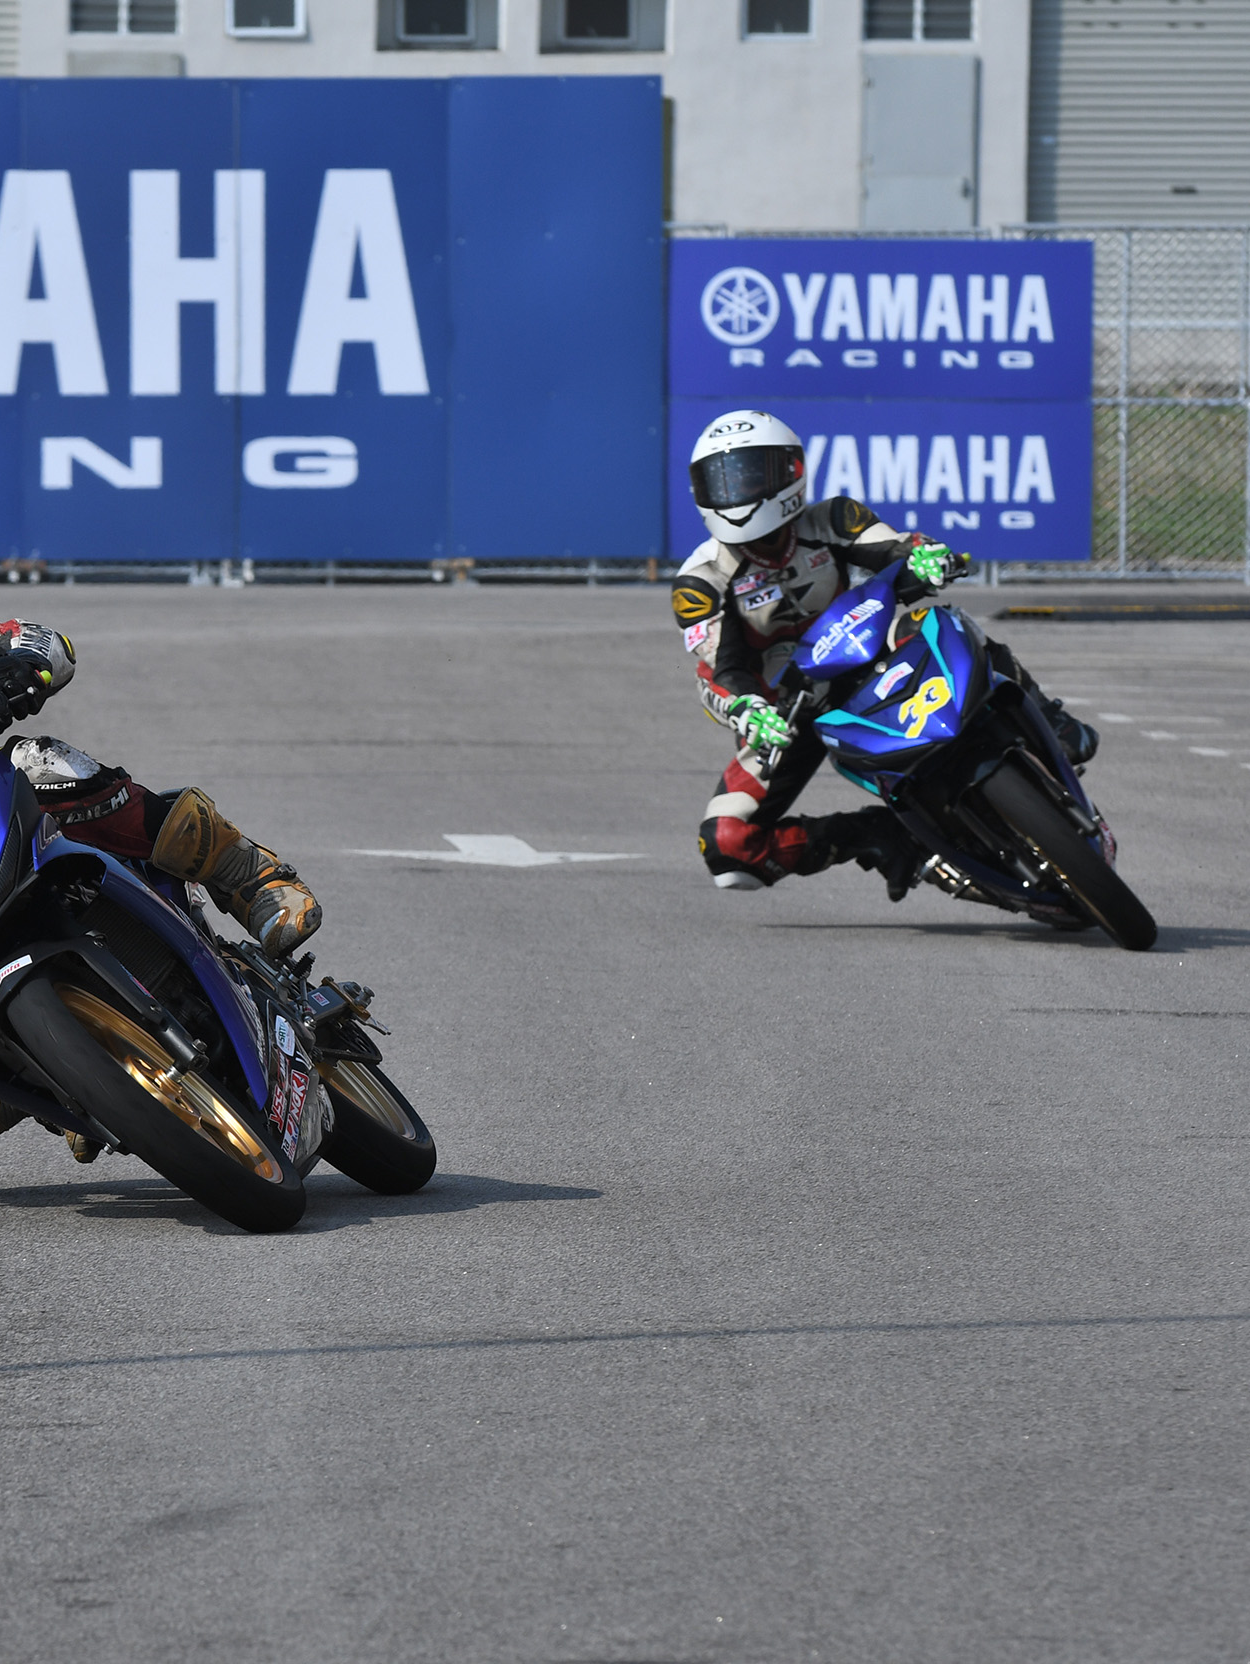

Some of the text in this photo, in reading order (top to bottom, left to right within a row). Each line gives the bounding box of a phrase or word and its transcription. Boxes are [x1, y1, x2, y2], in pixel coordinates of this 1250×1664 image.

[783, 273, 1054, 342] YAMAHA
[729, 348, 1034, 368] RACING
[805, 435, 1055, 503] YAMAHA
[33, 781, 77, 791] TAICHI
[269, 1084, 285, 1134] YSS
[290, 1081, 306, 1122] NGK
